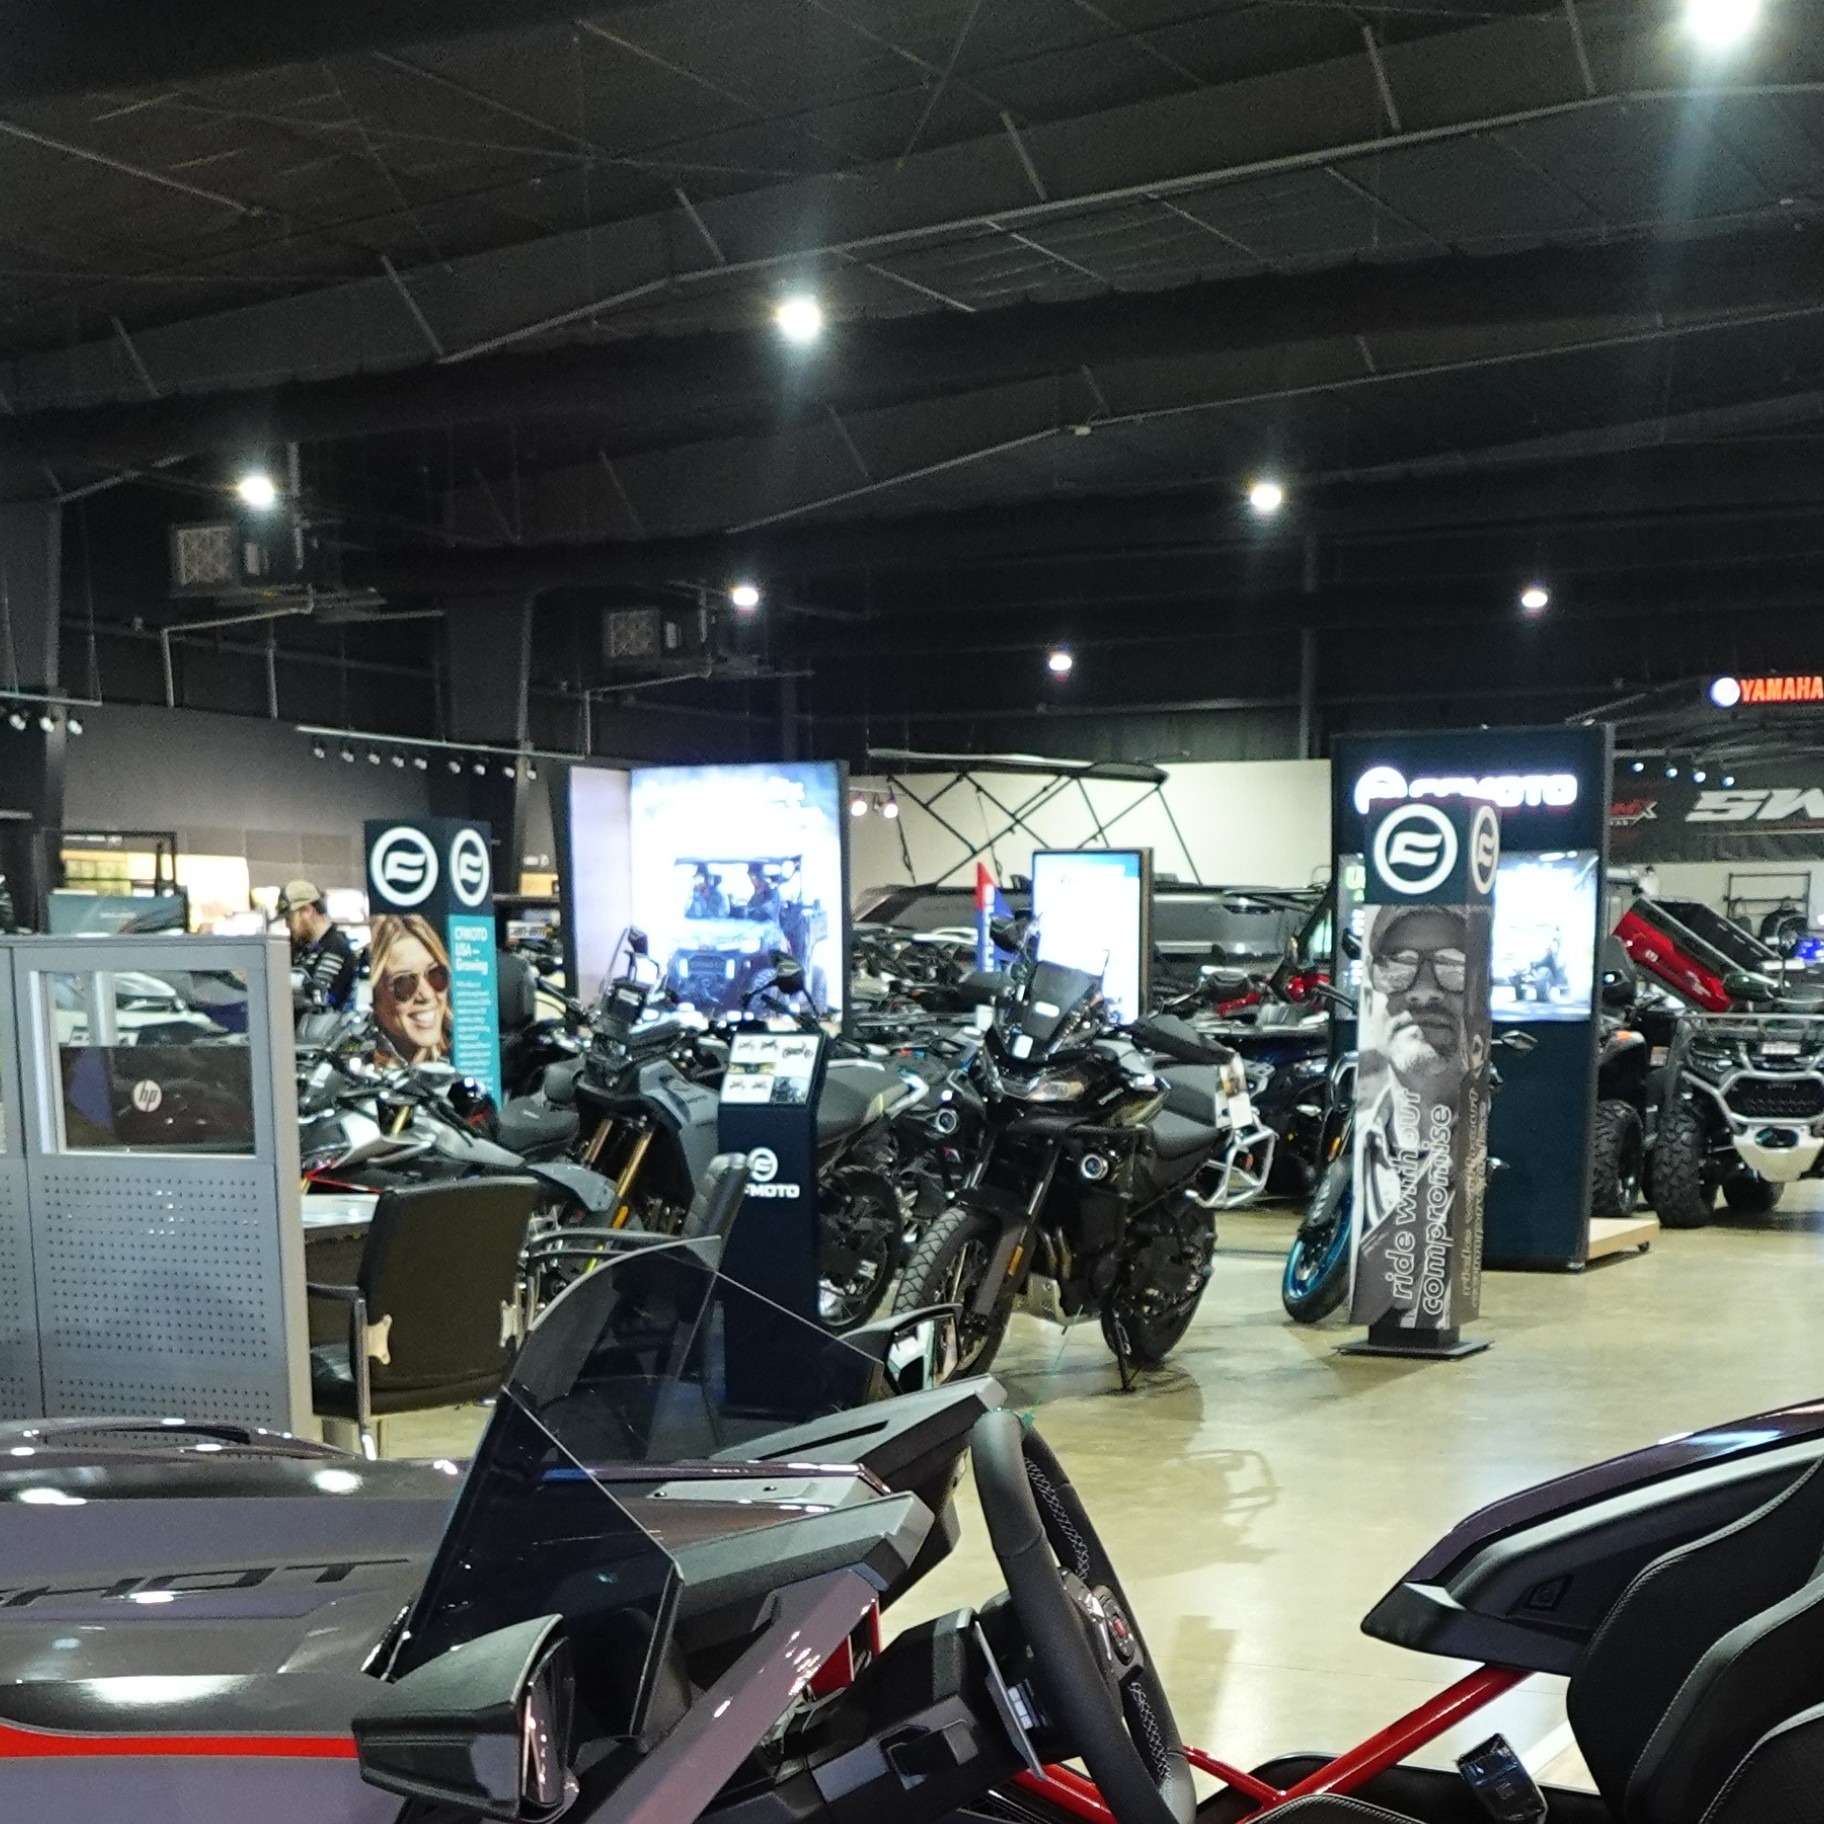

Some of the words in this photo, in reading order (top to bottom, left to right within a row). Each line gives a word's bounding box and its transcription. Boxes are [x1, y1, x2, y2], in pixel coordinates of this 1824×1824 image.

[1739, 676, 1824, 703] YAMAHA
[138, 1080, 158, 1111] hp
[1391, 1088, 1422, 1225] without
[745, 1183, 800, 1198] MOTO
[1421, 1104, 1454, 1315] compromise
[1385, 1231, 1416, 1300] ride
